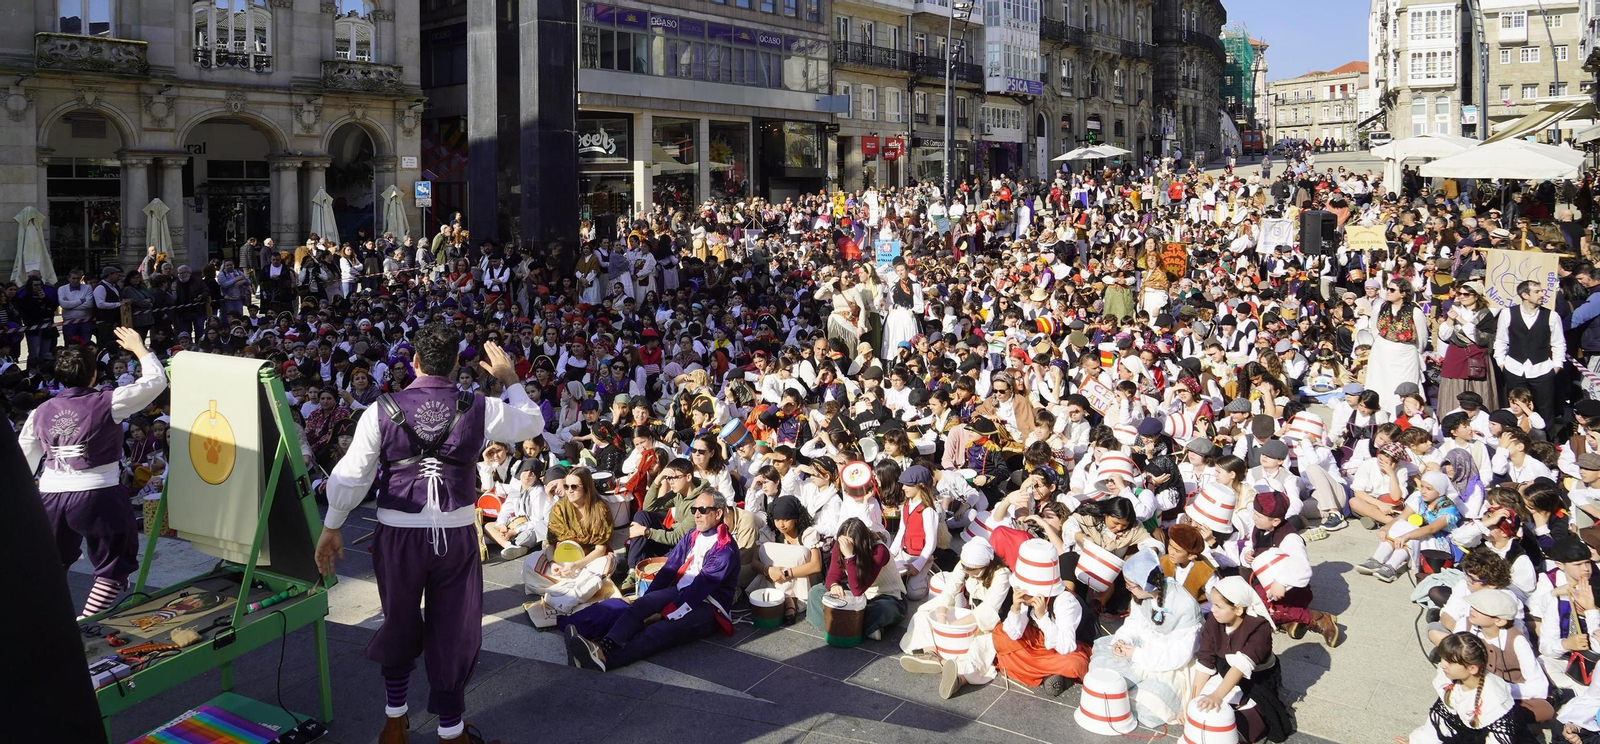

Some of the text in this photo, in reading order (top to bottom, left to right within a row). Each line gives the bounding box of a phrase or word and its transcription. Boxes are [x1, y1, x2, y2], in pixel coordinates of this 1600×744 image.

[650, 16, 677, 29] OCASO
[759, 34, 781, 45] OCASO
[233, 102, 239, 110] 6
[184, 141, 207, 155] ral
[923, 139, 945, 148] AS Compu
[1543, 271, 1558, 299] Praga
[1485, 286, 1505, 306] Niño
[692, 399, 708, 408] N
[338, 422, 353, 434] N
